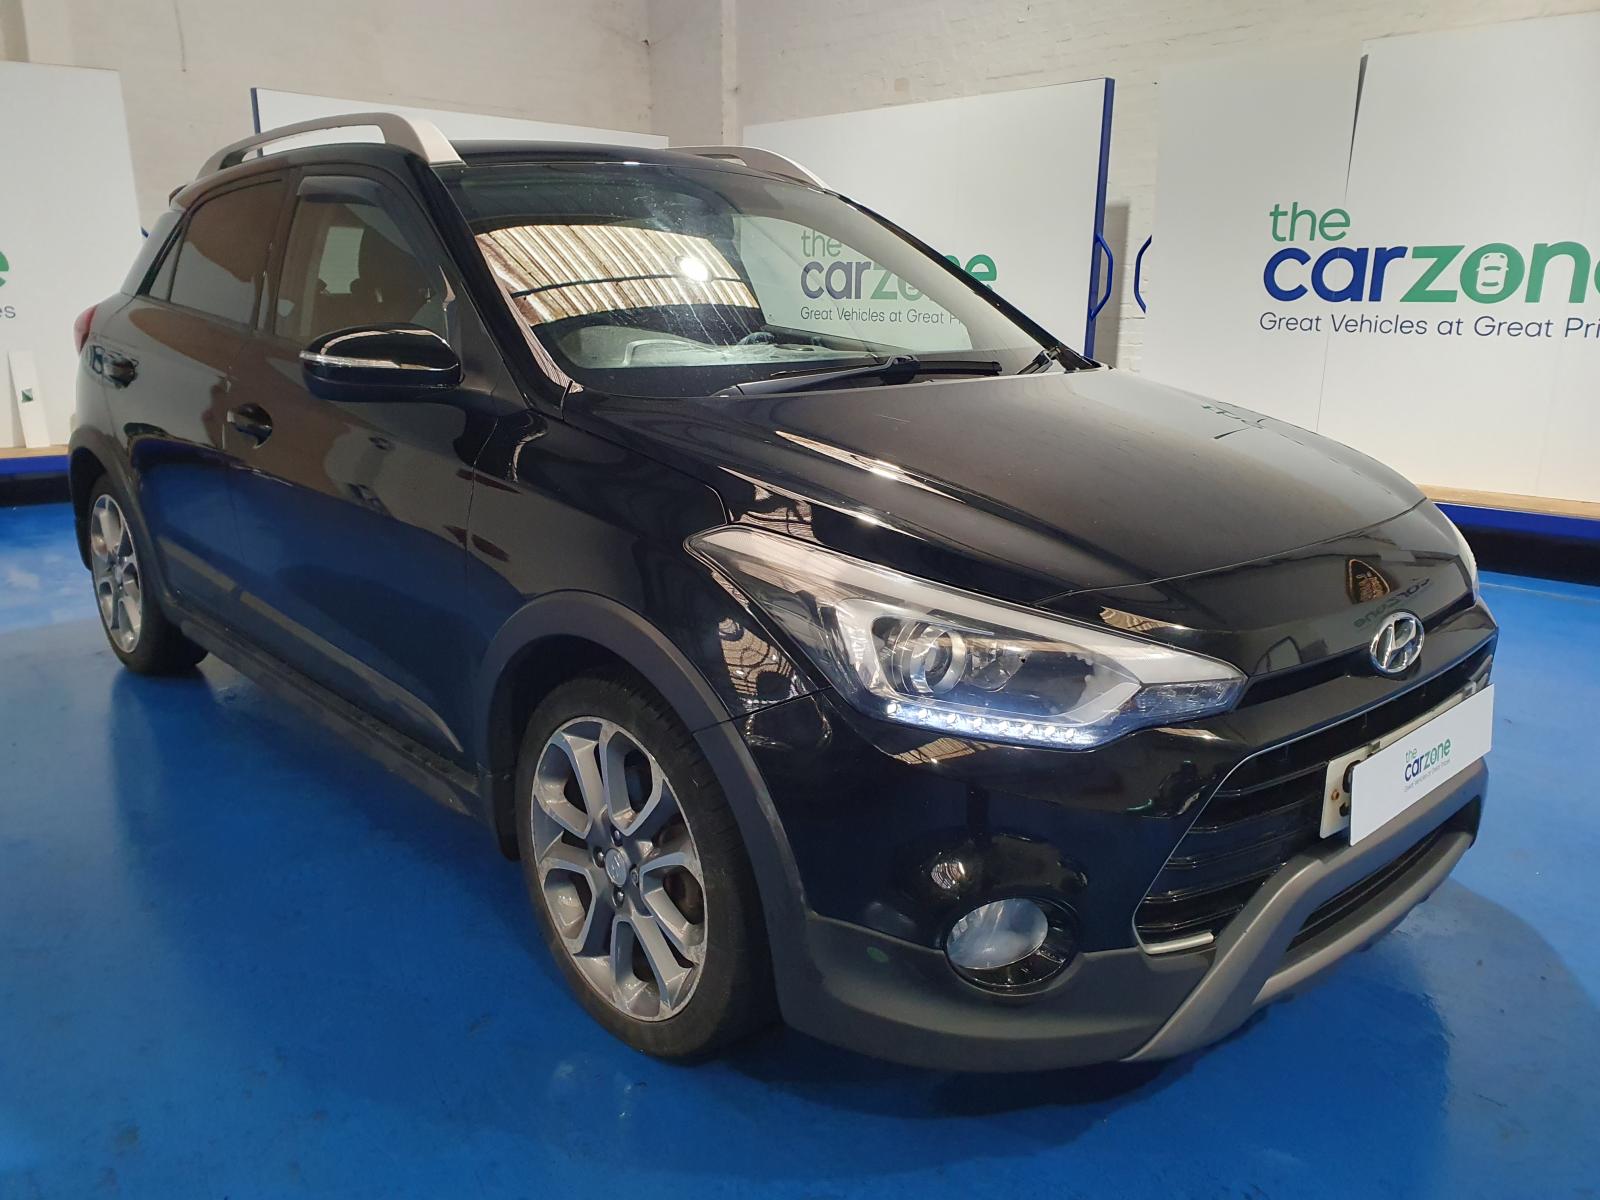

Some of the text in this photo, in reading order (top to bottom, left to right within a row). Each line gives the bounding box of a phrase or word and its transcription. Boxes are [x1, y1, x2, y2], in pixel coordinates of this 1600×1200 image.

[1269, 202, 1351, 242] the
[801, 230, 842, 257] the
[801, 254, 997, 300] carze
[1263, 241, 1600, 304] carzon
[801, 306, 833, 320] Great
[836, 308, 885, 321] Vehicles
[889, 310, 902, 322] at
[906, 309, 944, 324] Great
[1260, 312, 1322, 332] Great
[1331, 314, 1428, 335] Vehicles
[1437, 318, 1464, 336] at
[1474, 316, 1554, 338] Great
[1404, 738, 1451, 782] carzone
